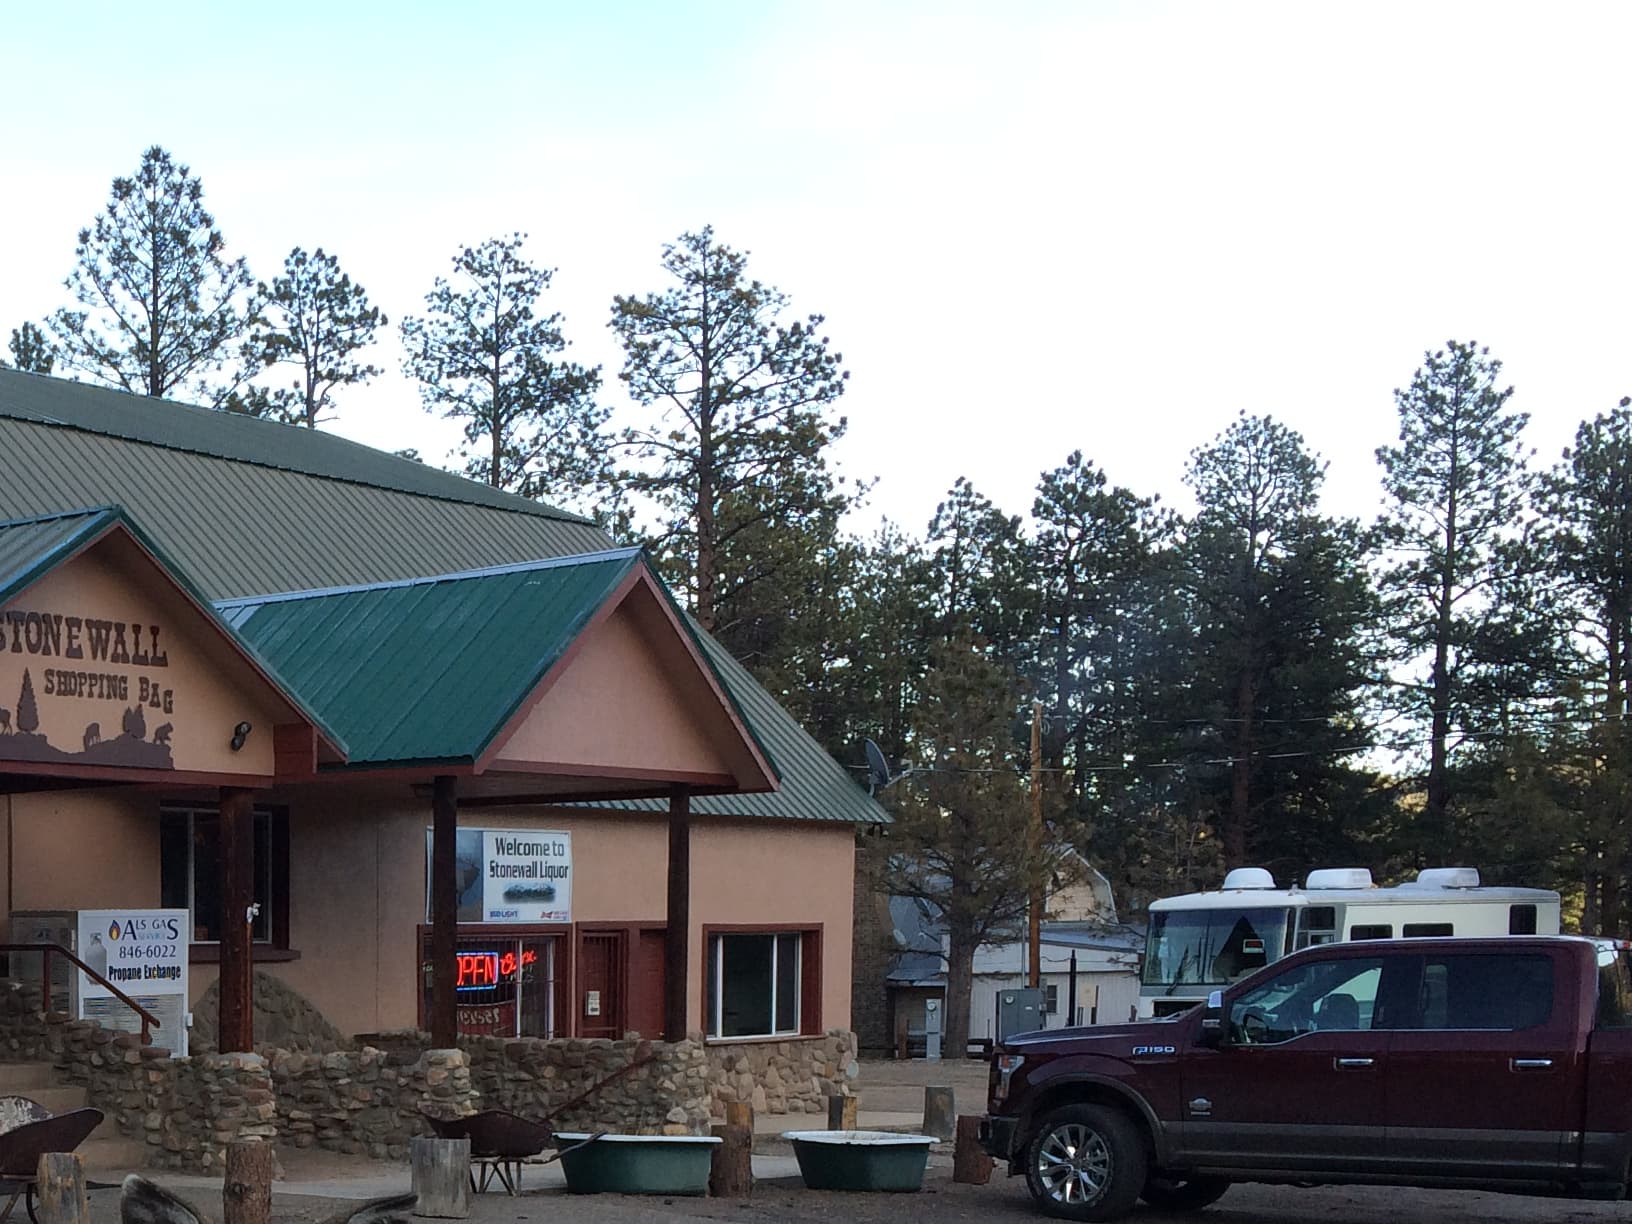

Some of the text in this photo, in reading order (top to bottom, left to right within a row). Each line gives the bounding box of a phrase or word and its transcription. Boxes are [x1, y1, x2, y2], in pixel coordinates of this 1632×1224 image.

[44, 668, 174, 714] SHOPPING BAG
[495, 837, 565, 857] Welcome to
[489, 860, 569, 882] Stonewall Liquor
[119, 945, 176, 959] 846-6022
[108, 963, 182, 982] Propane Exchange
